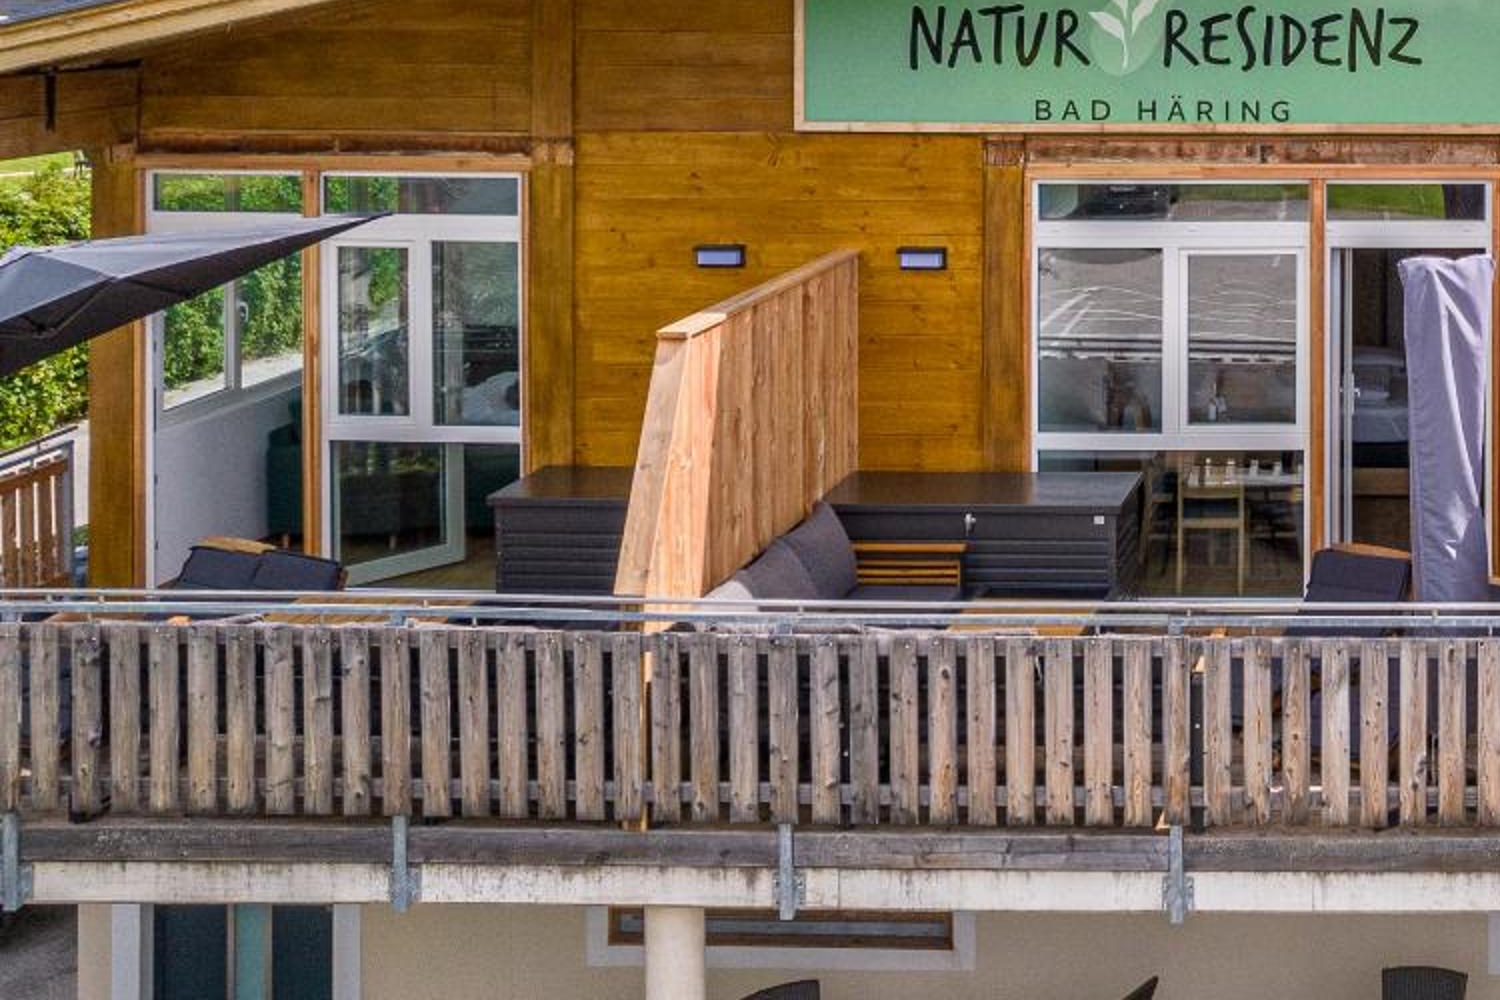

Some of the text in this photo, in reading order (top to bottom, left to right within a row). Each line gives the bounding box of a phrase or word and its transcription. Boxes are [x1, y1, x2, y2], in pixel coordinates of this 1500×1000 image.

[908, 3, 1423, 73] NATUR RESIDENZ
[1035, 95, 1291, 123] BAD HÄRING
